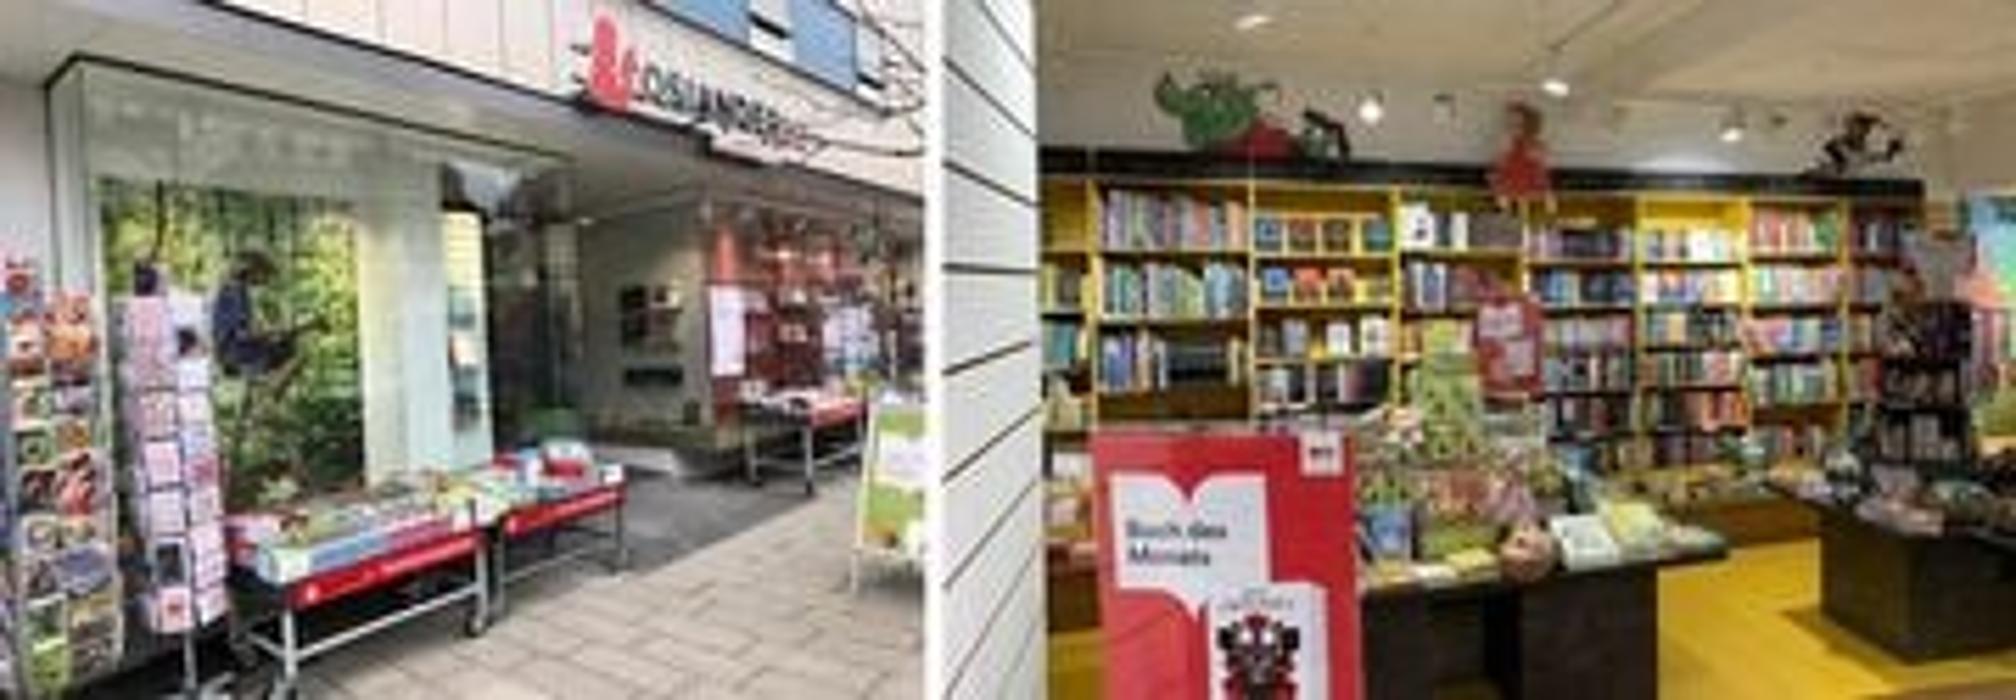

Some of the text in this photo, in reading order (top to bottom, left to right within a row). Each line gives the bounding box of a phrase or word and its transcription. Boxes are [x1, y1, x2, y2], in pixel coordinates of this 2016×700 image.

[1127, 518, 1228, 539] Buch des
[1128, 545, 1212, 567] Monats
